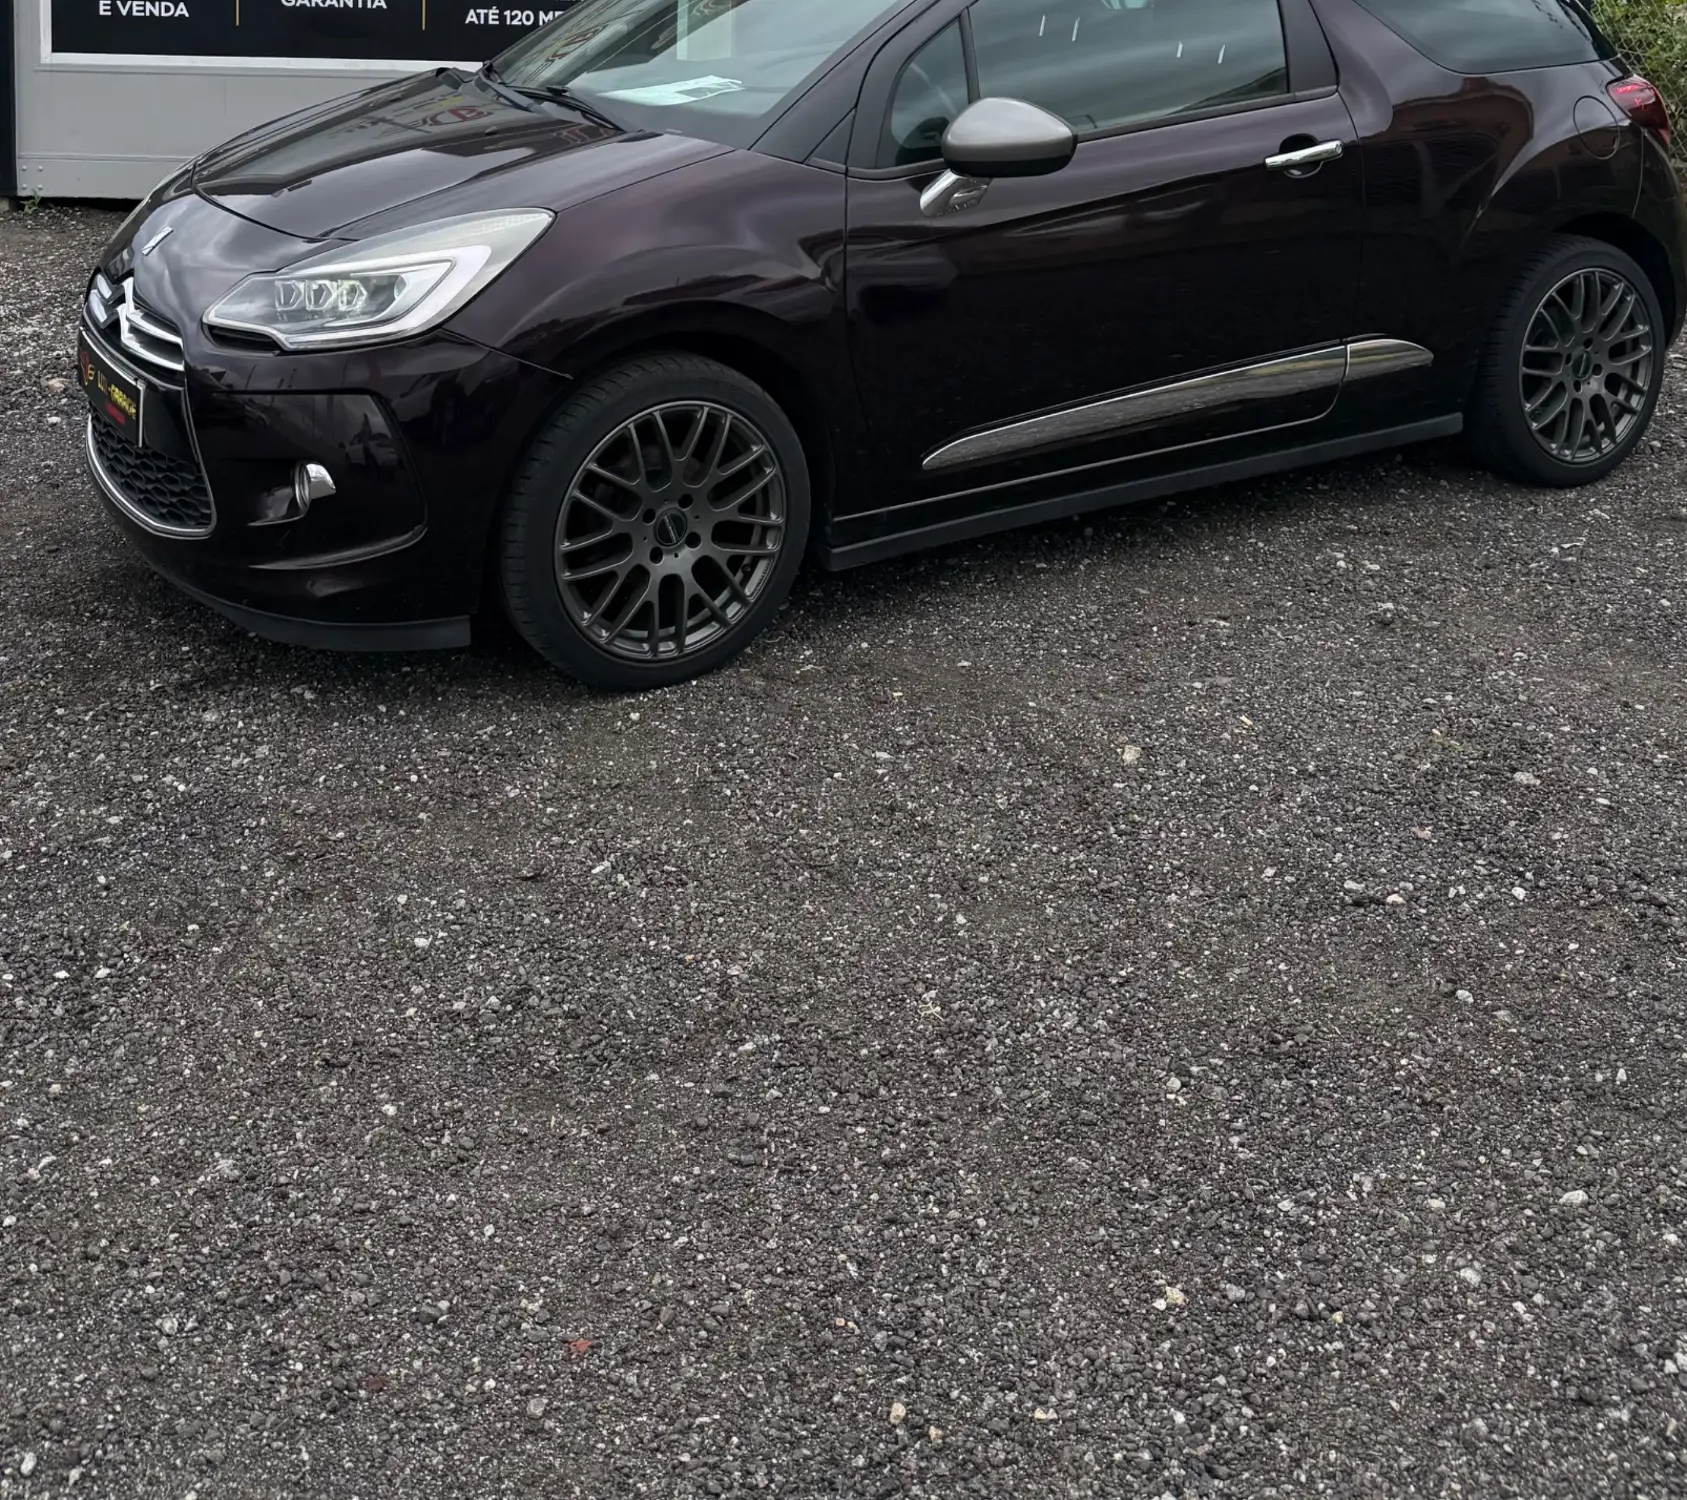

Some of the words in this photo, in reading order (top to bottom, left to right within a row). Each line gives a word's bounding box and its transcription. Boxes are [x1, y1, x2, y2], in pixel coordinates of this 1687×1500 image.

[99, 0, 112, 16] E
[116, 1, 190, 17] VENDA
[465, 6, 500, 25] ATÉ
[504, 9, 534, 26] 120
